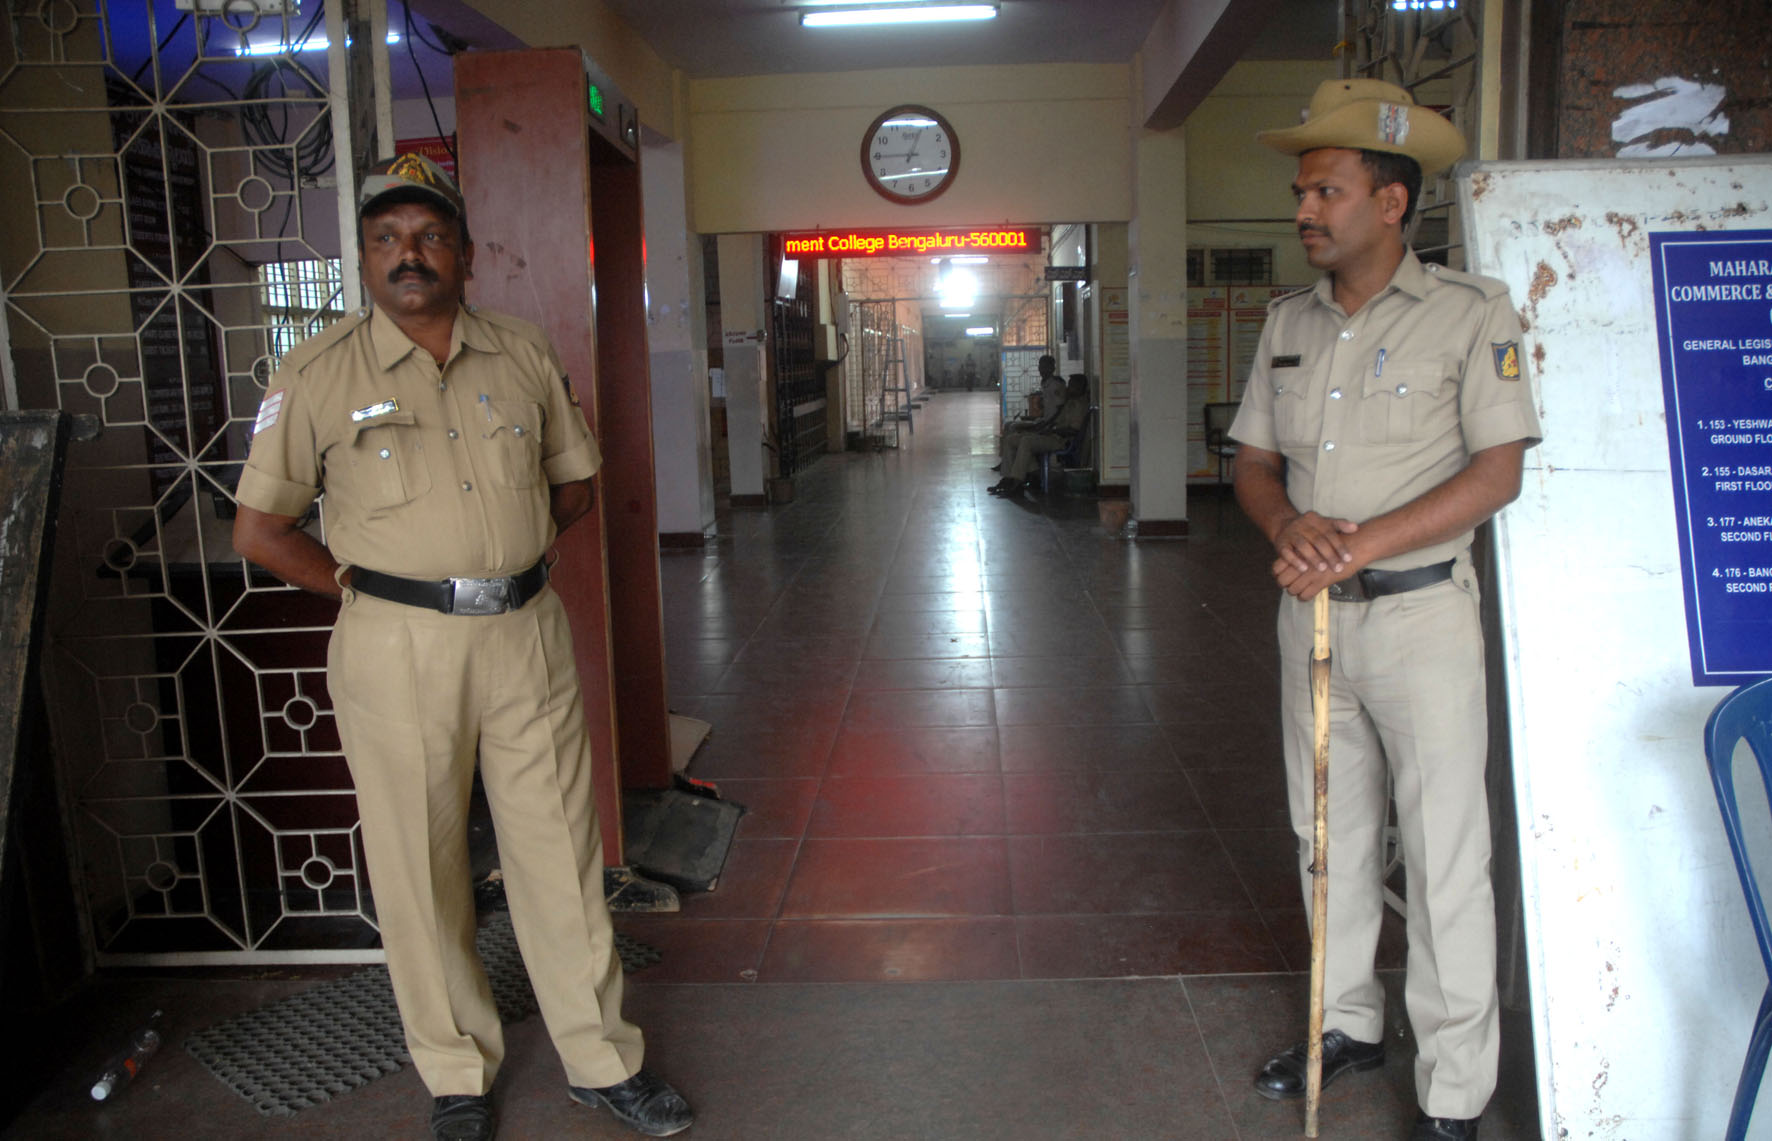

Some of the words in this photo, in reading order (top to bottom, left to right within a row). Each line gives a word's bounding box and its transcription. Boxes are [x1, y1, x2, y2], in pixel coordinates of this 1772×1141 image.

[878, 136, 888, 145] 10
[935, 134, 942, 142] 2
[940, 150, 946, 159] 3
[880, 168, 886, 176] 8
[892, 180, 898, 188] 7
[908, 184, 915, 192] 6
[925, 179, 931, 187] 5
[786, 237, 824, 253] ment
[828, 234, 884, 254] College
[888, 231, 1026, 252] Bengaluru-560001
[1671, 285, 1761, 302] COMMERCE
[1683, 340, 1736, 351] GENERAL
[1709, 420, 1726, 430] 153
[1710, 434, 1753, 444] GROUND
[1714, 466, 1731, 477] 155
[1715, 481, 1743, 491] FIRST
[1745, 481, 1772, 491] FLOO
[1719, 517, 1736, 527] 177
[1721, 532, 1762, 542] SECOND
[1725, 568, 1741, 578] 176
[1726, 583, 1768, 593] SECOND
